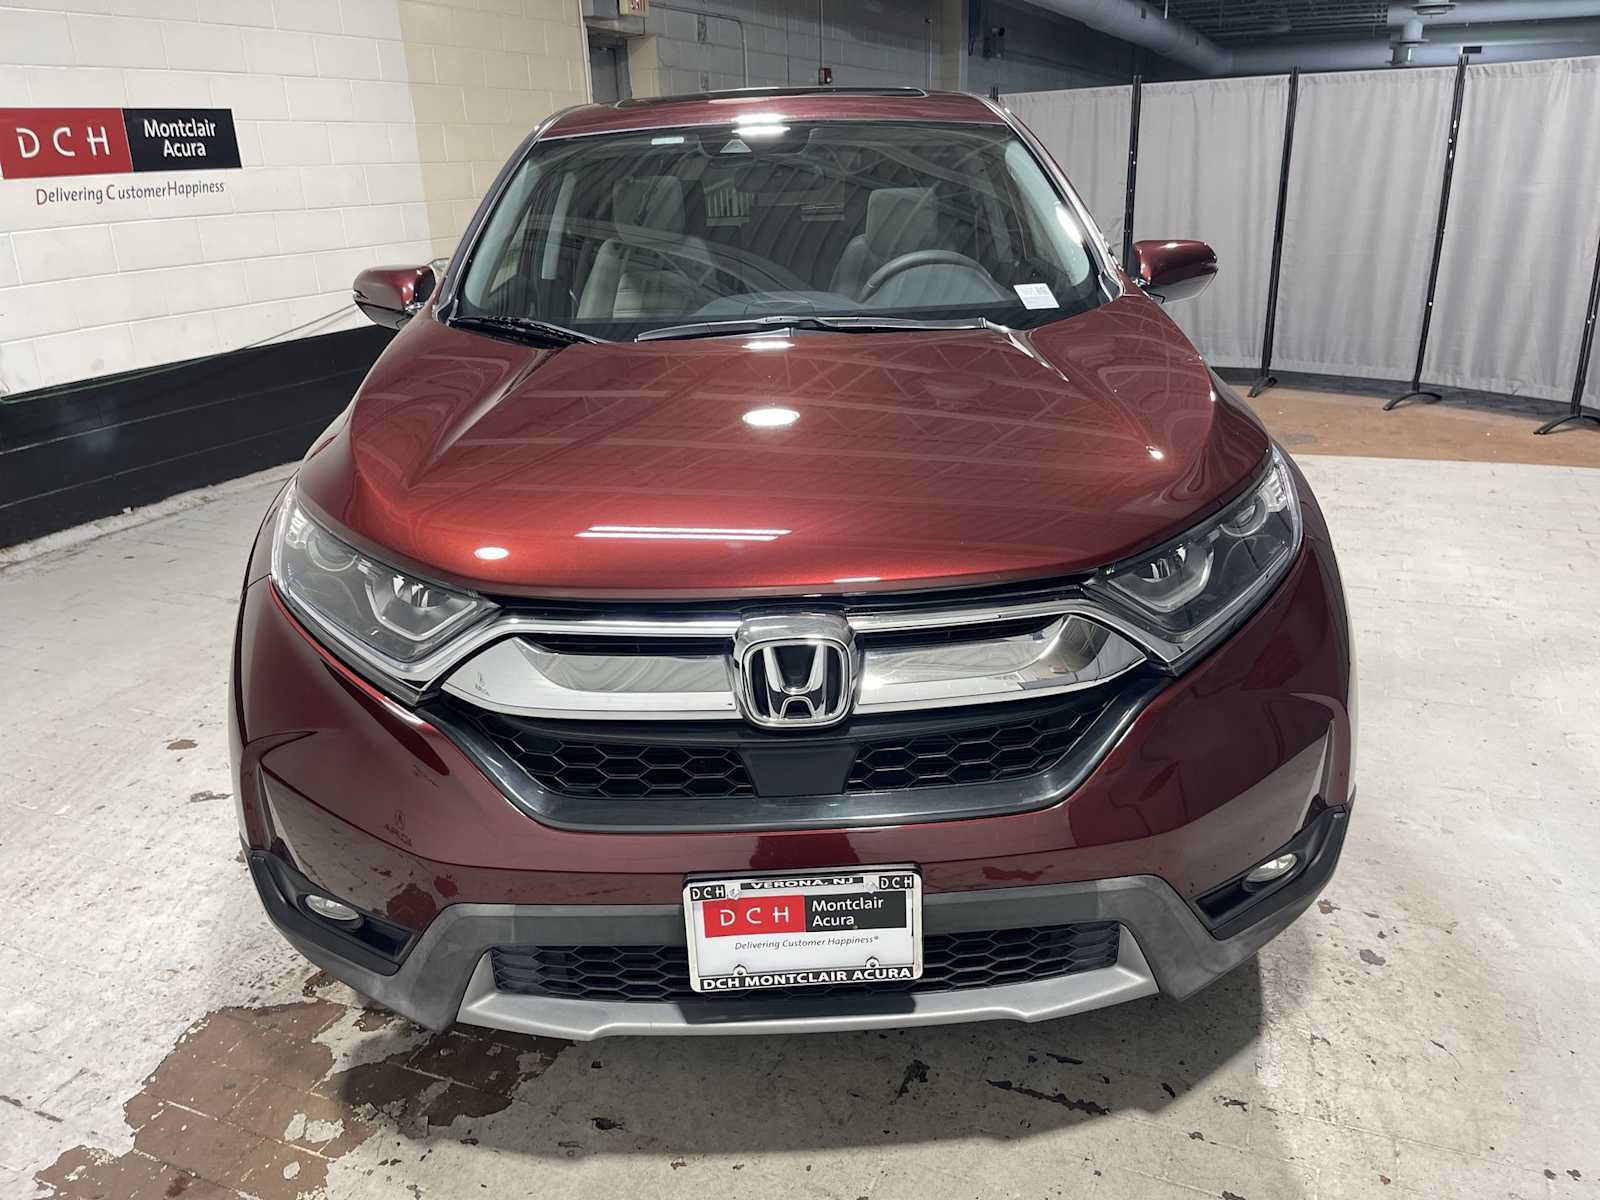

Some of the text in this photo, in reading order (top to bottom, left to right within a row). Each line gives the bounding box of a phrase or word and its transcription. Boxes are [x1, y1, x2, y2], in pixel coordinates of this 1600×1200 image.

[143, 118, 216, 139] Montclair
[163, 139, 206, 158] Acura
[36, 187, 103, 205] Delivering
[751, 877, 854, 889] VERONA, NJ
[880, 876, 913, 889] DCH
[692, 886, 725, 900] DCH
[812, 896, 884, 912] Montclair
[812, 915, 855, 927] Acura
[735, 940, 780, 950] Delivering
[782, 939, 825, 948] Customer
[703, 967, 911, 990] DCH MONTCLAIR ACURA
